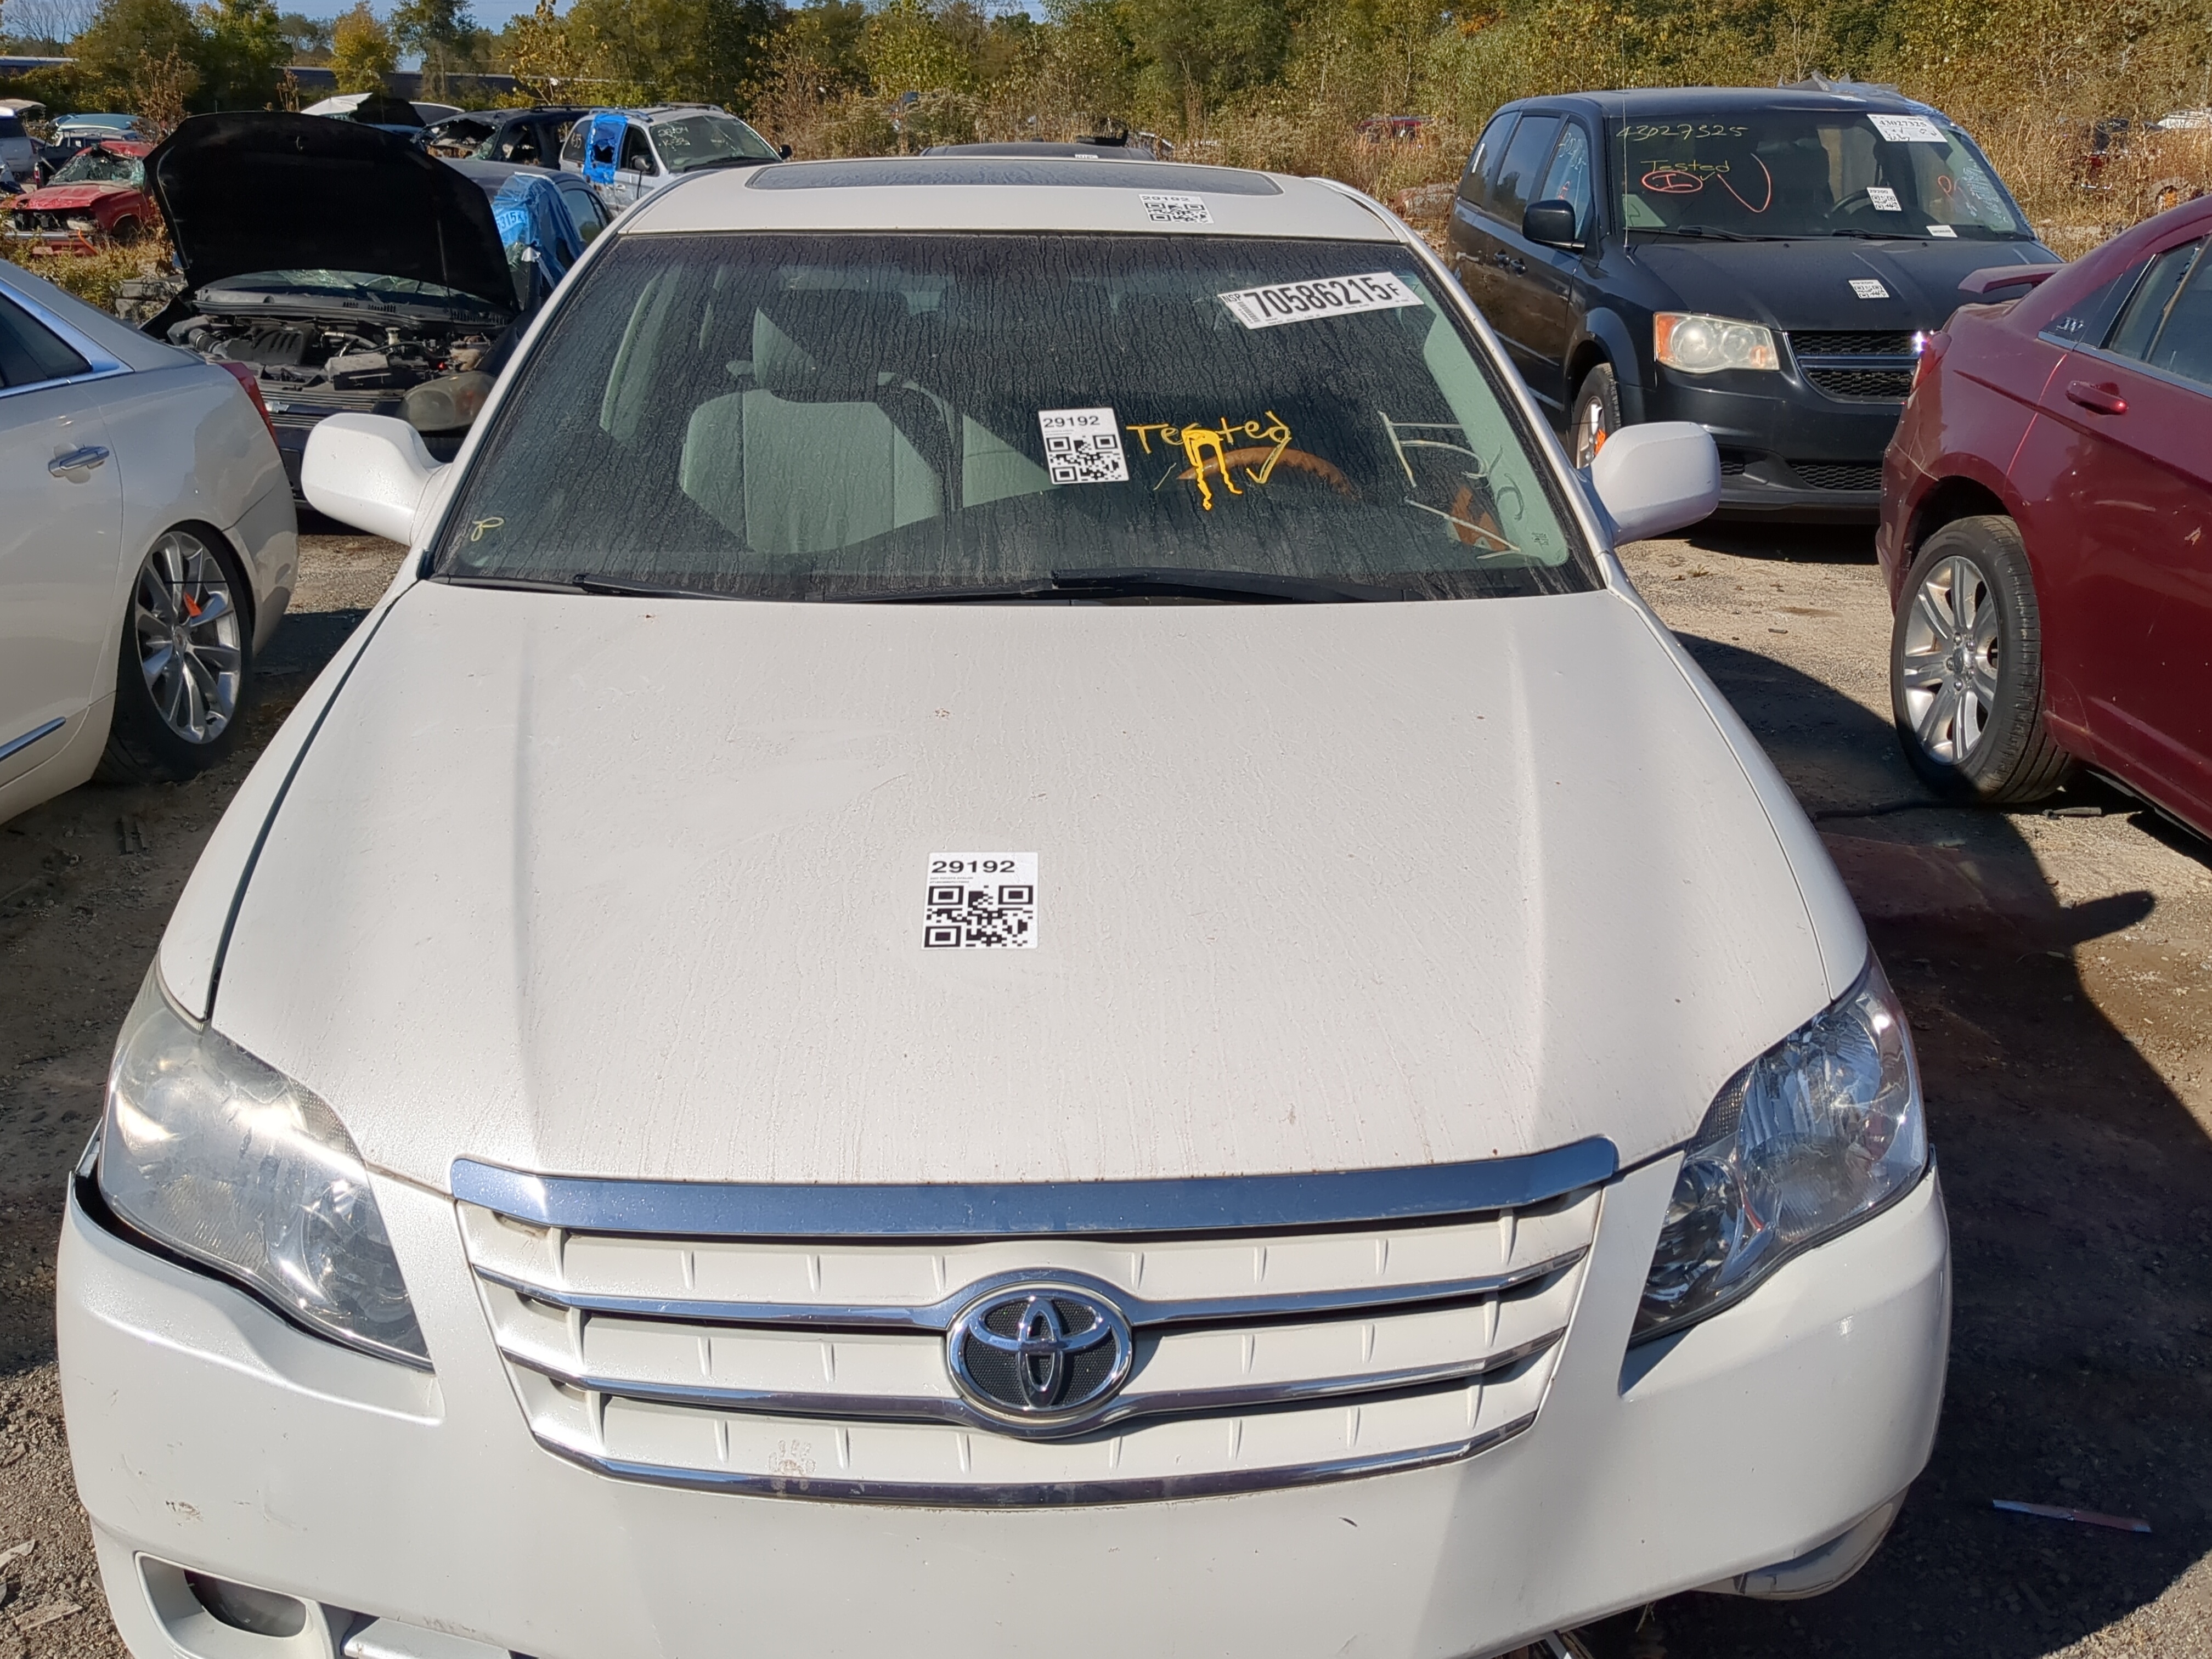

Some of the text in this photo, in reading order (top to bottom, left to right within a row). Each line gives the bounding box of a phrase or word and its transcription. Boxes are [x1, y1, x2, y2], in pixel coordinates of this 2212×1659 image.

[1640, 159, 1730, 172] Tested
[1243, 276, 1392, 318] 70586215
[1043, 415, 1101, 428] 29192
[931, 860, 1015, 873] 29192
